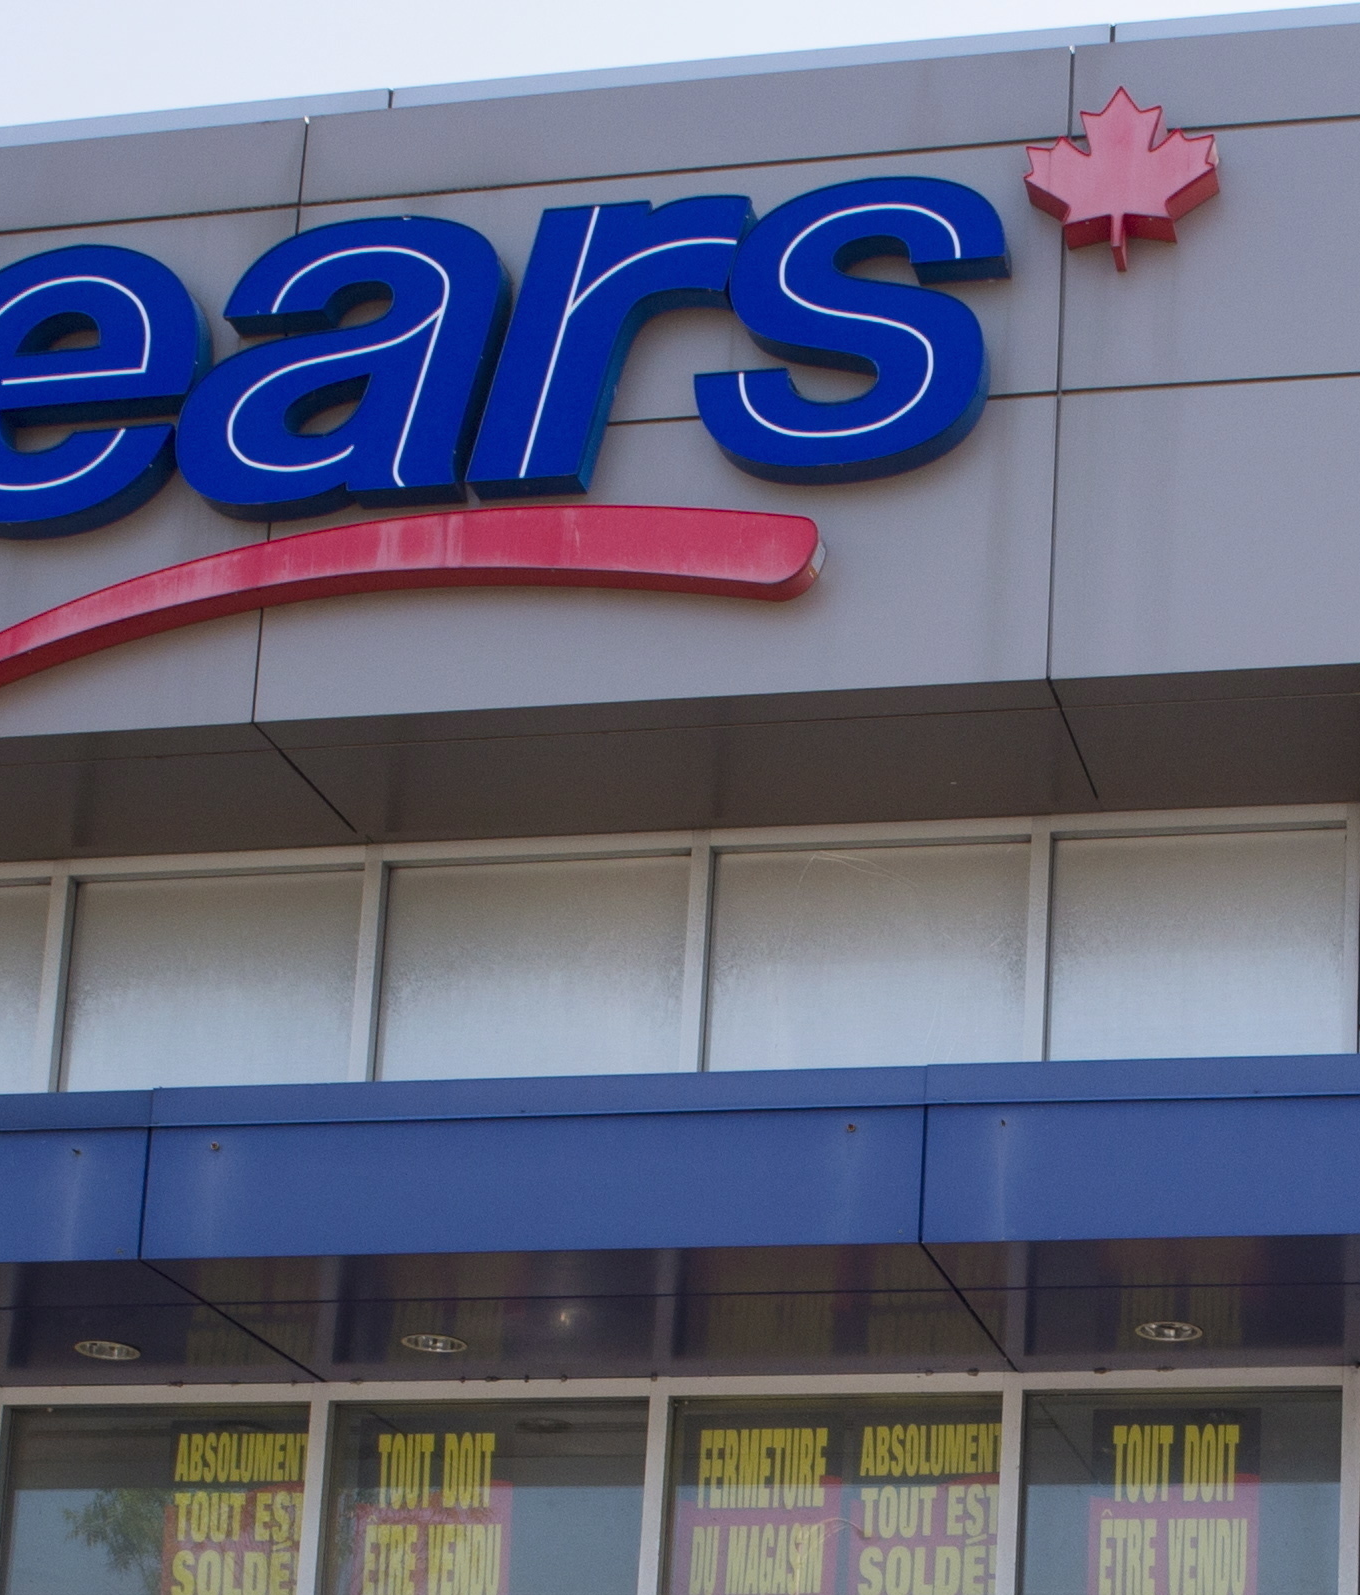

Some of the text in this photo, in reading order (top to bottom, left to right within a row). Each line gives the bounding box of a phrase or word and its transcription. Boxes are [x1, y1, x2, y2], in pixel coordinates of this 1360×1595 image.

[378, 1432, 495, 1510] TOUT DOIT
[697, 1428, 828, 1509] FERMETURE
[1113, 1424, 1240, 1503] TOUT DOIT
[174, 1491, 246, 1542] TOUT
[860, 1485, 937, 1538] TOUT
[725, 1523, 825, 1595] MAGASIN
